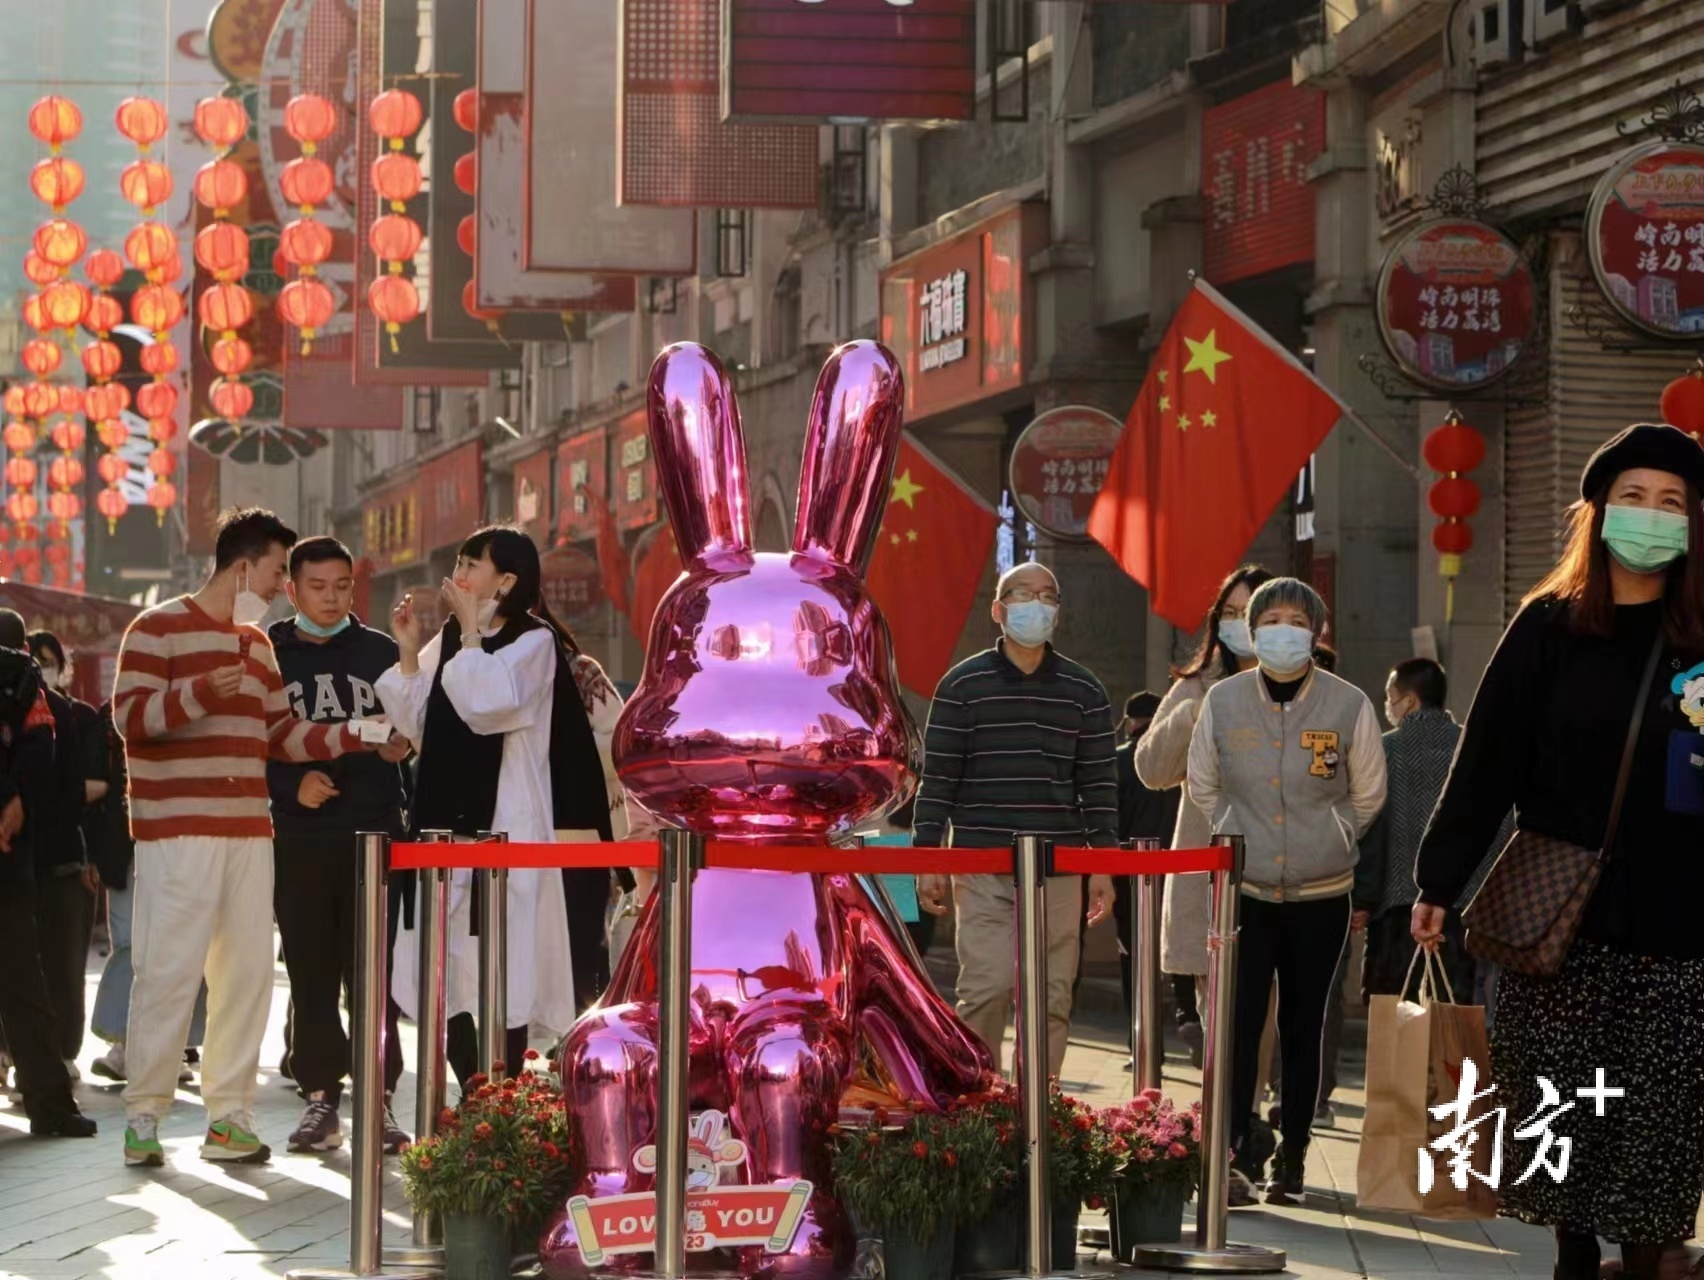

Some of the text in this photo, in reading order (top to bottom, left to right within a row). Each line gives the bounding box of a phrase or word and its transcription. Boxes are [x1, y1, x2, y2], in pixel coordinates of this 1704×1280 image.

[284, 673, 375, 720] GAP
[603, 1216, 656, 1235] LOV
[716, 1206, 775, 1228] YOU
